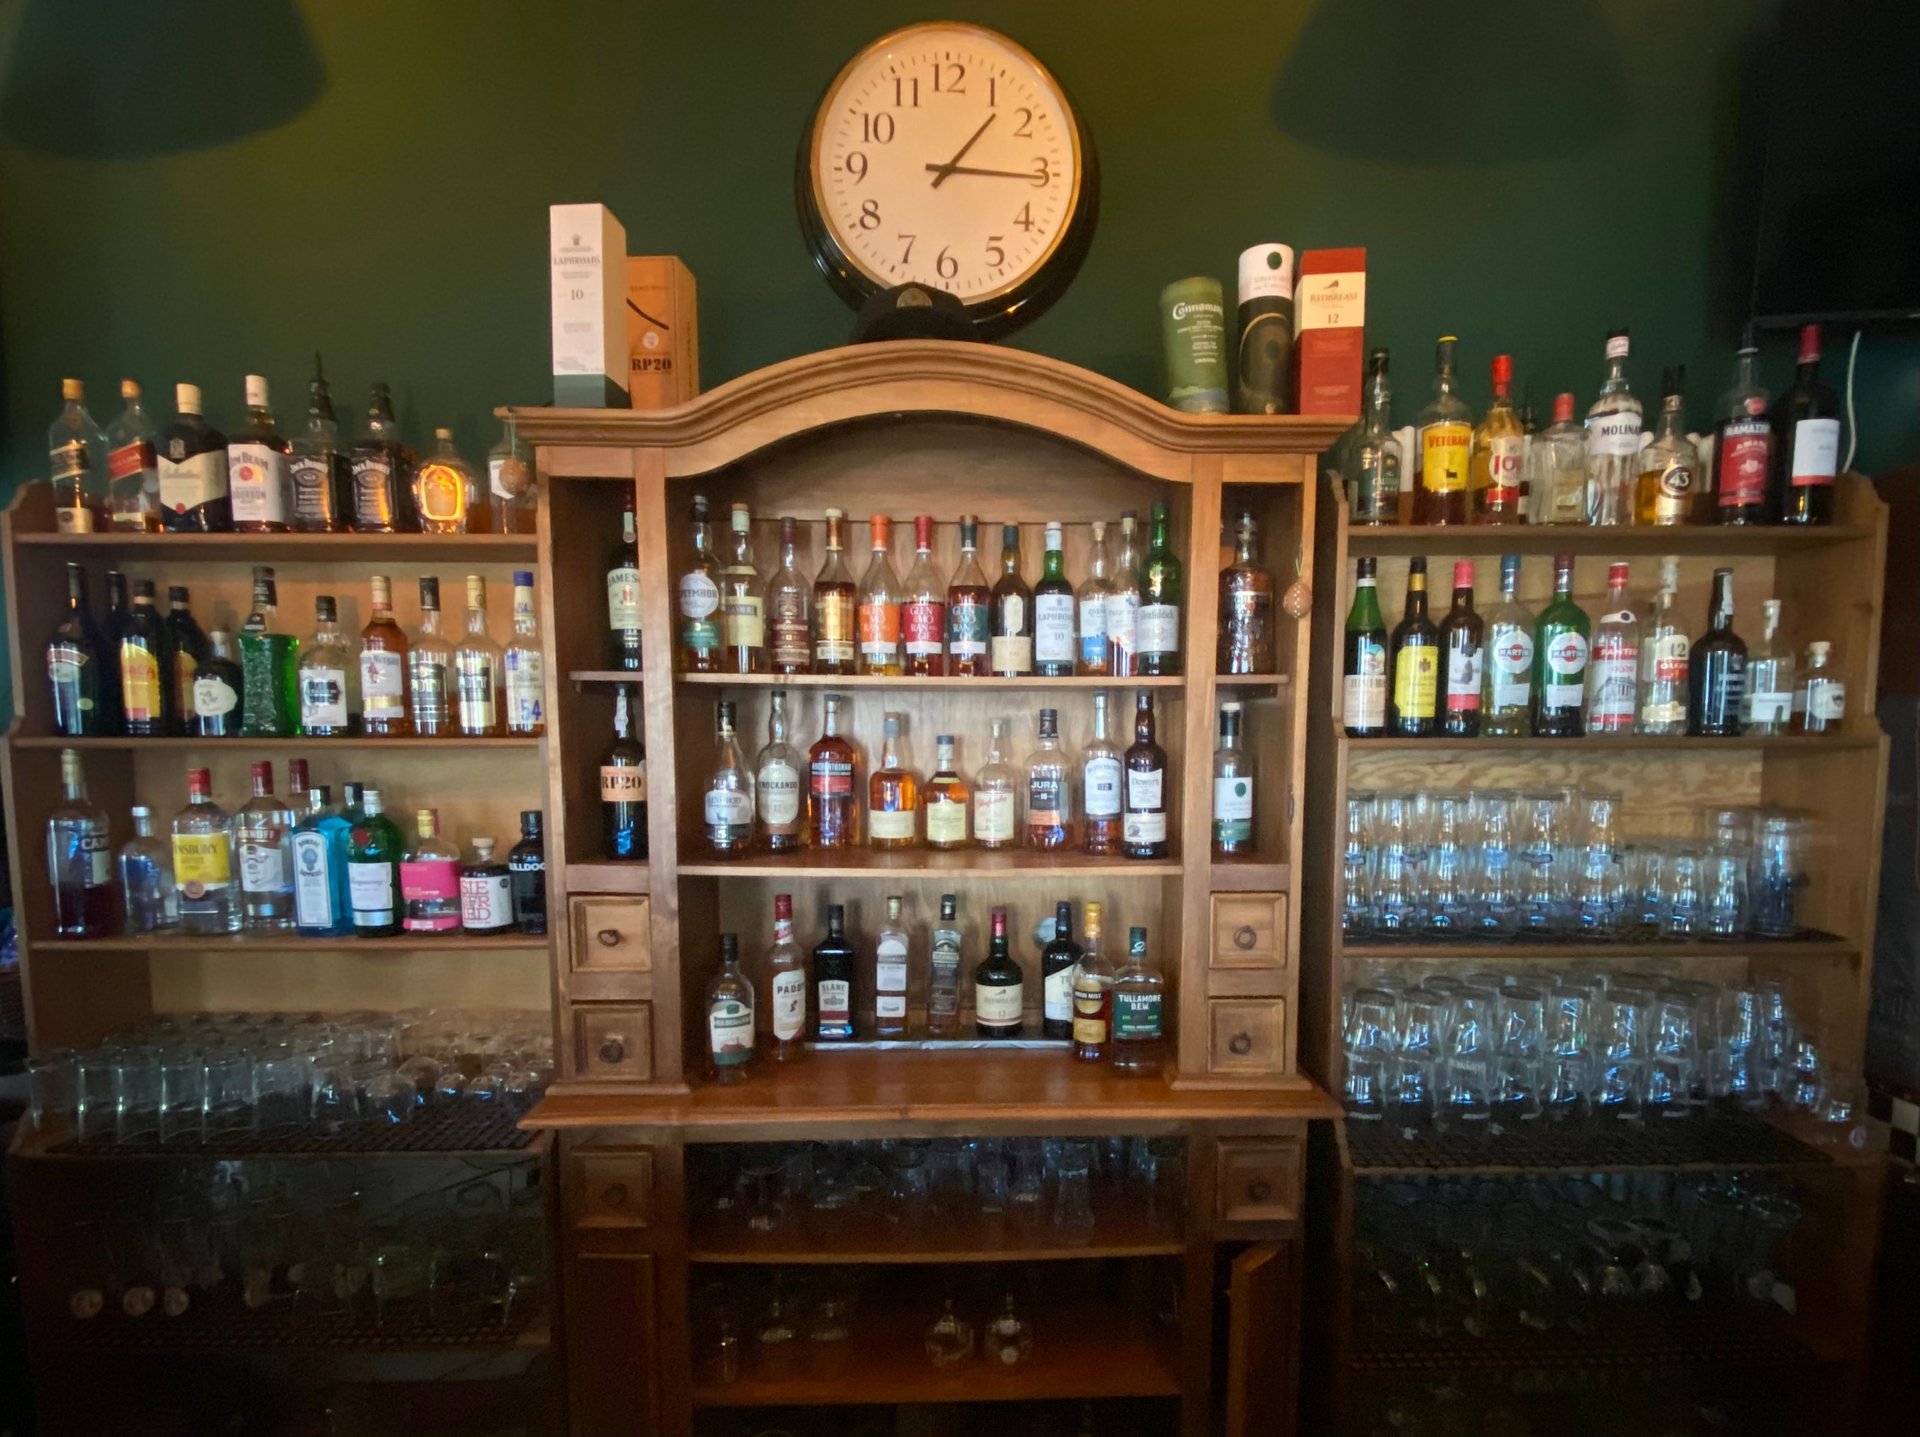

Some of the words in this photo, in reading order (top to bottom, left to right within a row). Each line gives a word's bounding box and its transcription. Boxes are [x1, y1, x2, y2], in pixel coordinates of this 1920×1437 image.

[892, 77, 921, 108] 11
[931, 63, 966, 95] 12
[986, 77, 999, 108] 1
[860, 111, 895, 144] 10
[1012, 107, 1034, 139] 2
[845, 151, 868, 185] 9
[1030, 156, 1051, 188] 3
[859, 199, 882, 231] 8
[1012, 201, 1036, 233] 4
[897, 234, 917, 265] 7
[936, 245, 959, 279] 6
[984, 235, 1006, 268] 5
[570, 288, 584, 301] 10
[1327, 313, 1340, 324] 12
[632, 358, 672, 371] RP20
[1668, 471, 1690, 488] 43
[521, 698, 542, 721] 54
[1030, 781, 1059, 789] JURA
[777, 983, 805, 995] PADD
[1118, 993, 1162, 1003] TULLAMORE
